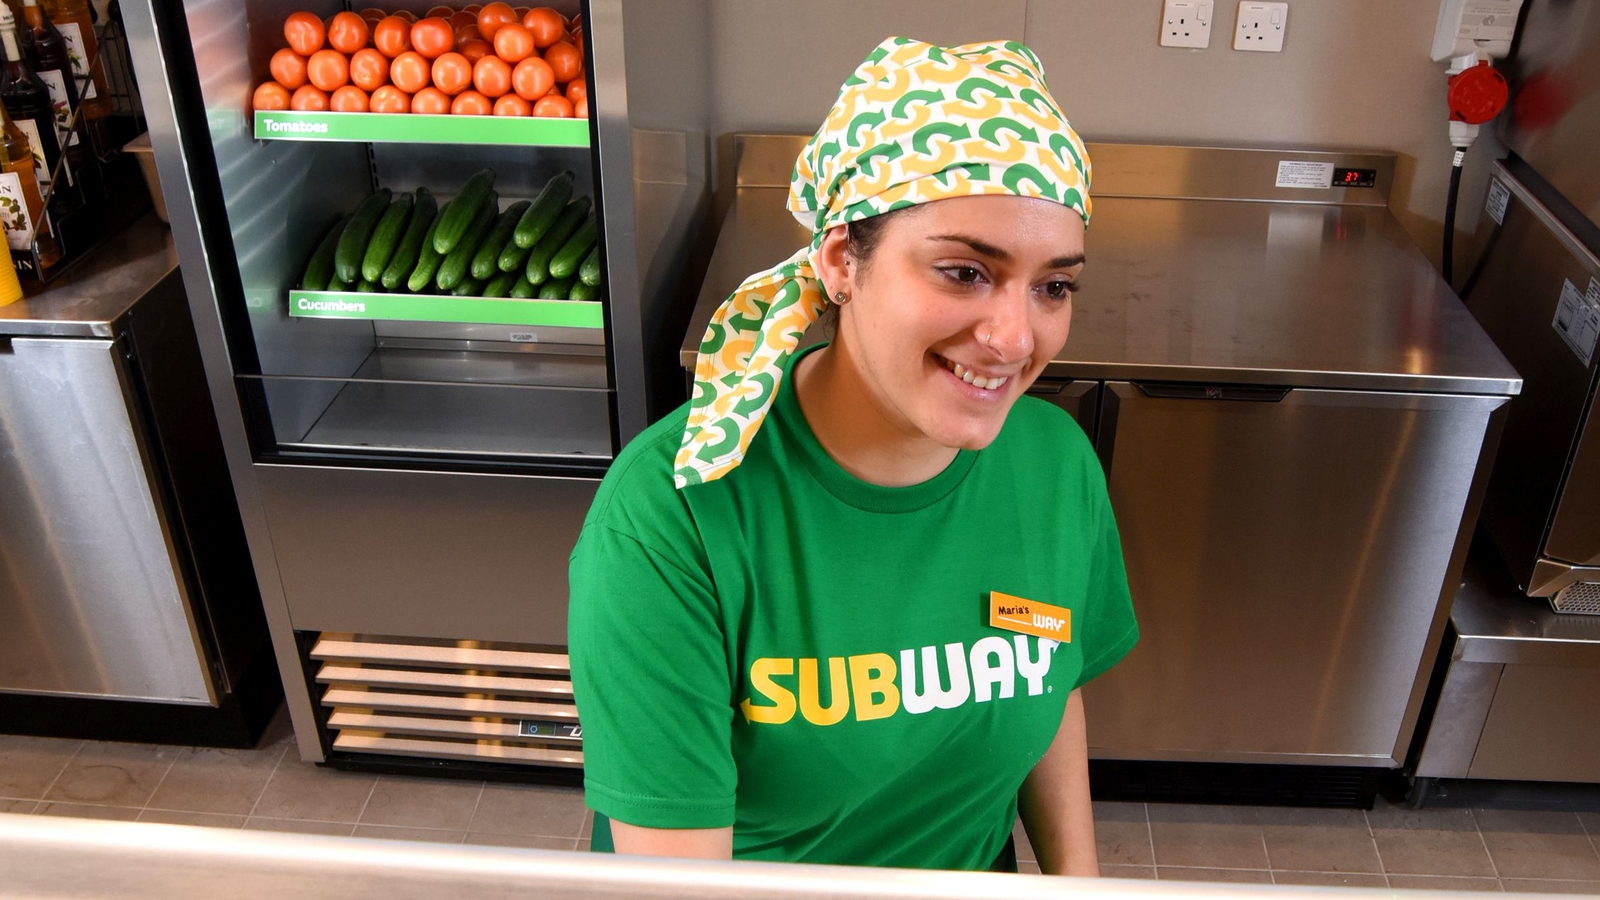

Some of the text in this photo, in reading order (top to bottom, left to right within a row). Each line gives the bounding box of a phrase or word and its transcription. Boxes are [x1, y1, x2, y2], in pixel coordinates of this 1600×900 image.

[263, 118, 329, 133] Tomatoes
[1345, 172, 1359, 182] 37
[297, 298, 366, 313] Cucumbers
[998, 605, 1030, 615] Maria's
[1032, 613, 1066, 632] WAY
[740, 634, 1061, 726] SUBWAY
